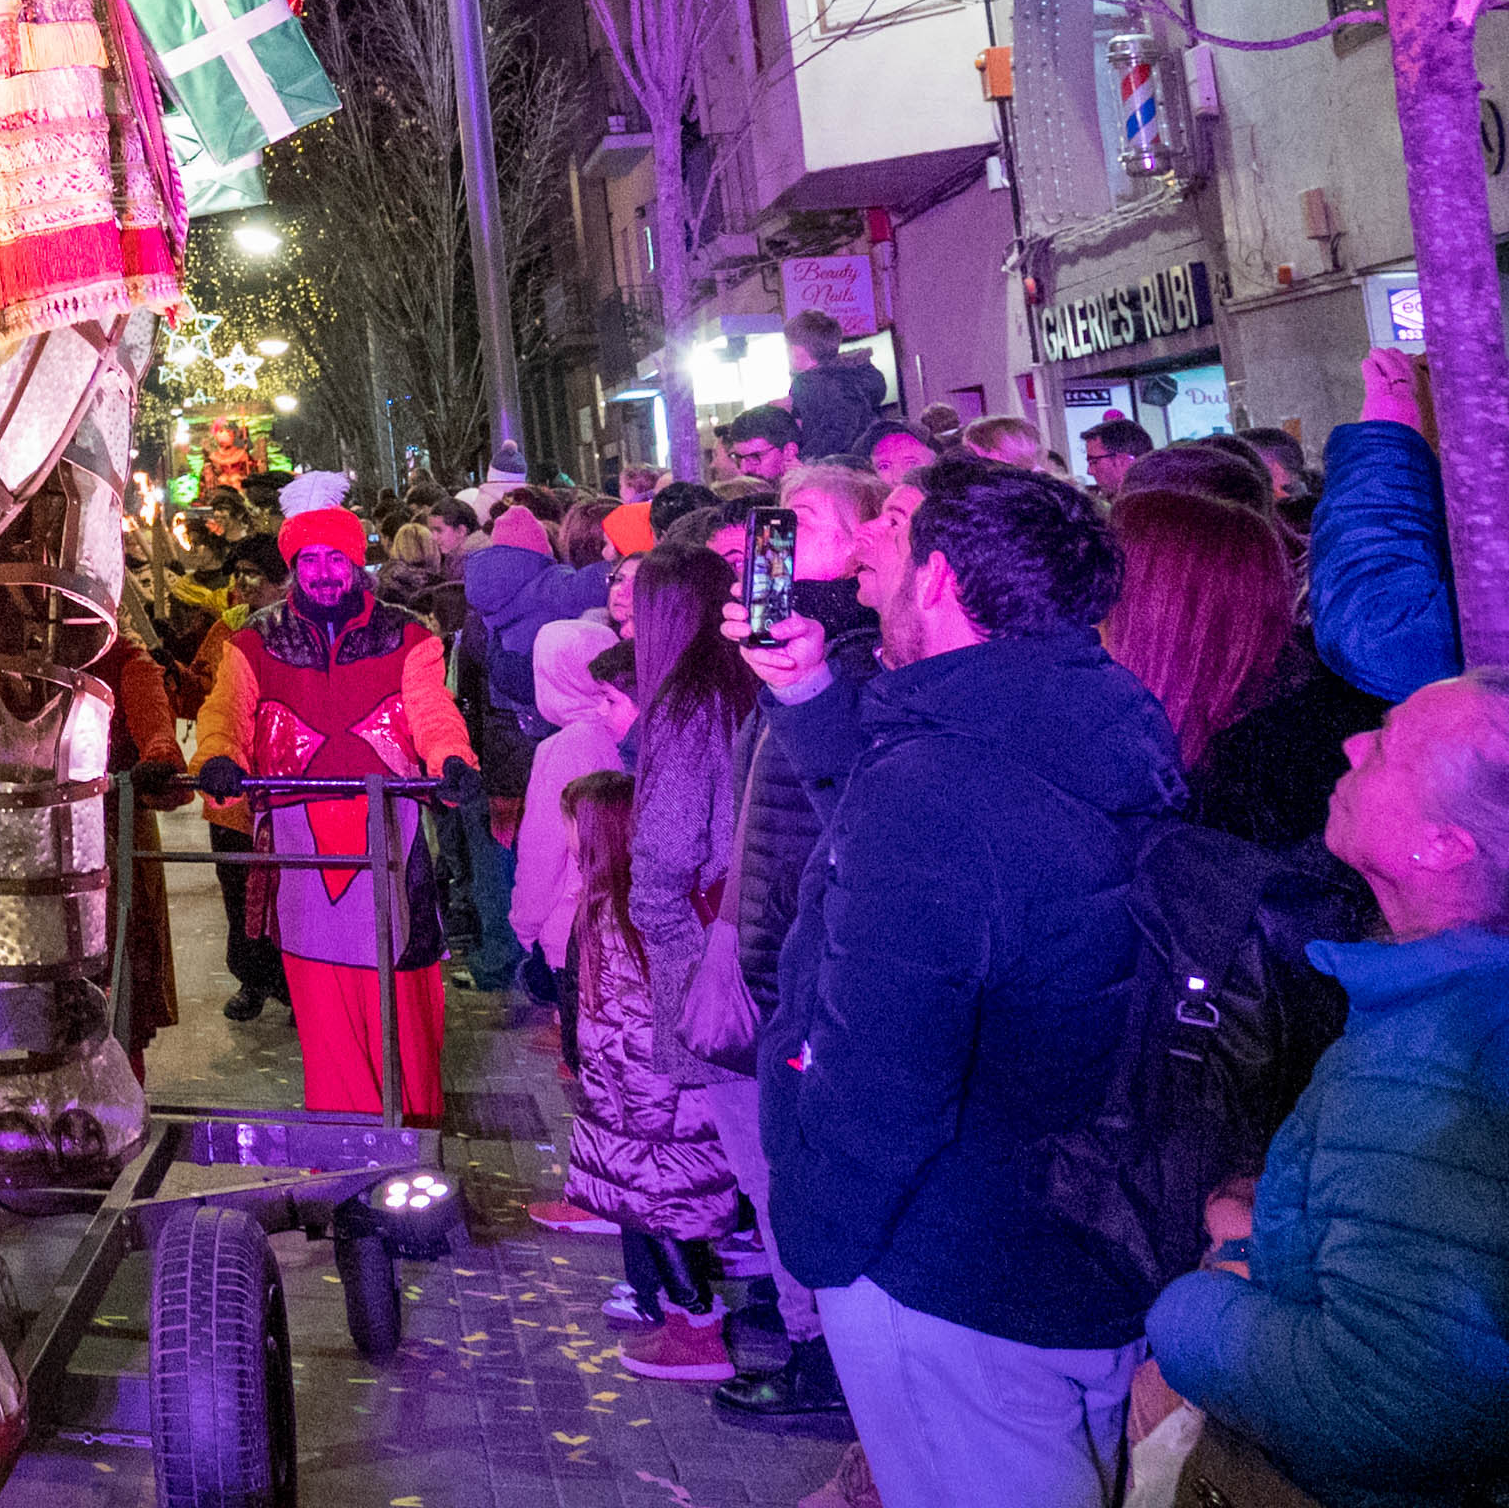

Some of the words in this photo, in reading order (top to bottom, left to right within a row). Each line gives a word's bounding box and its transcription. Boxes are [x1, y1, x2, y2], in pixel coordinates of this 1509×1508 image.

[794, 261, 860, 284] Beauty
[801, 284, 858, 305] Nails
[1041, 284, 1135, 362] GALERIES
[1139, 264, 1199, 339] RUBI
